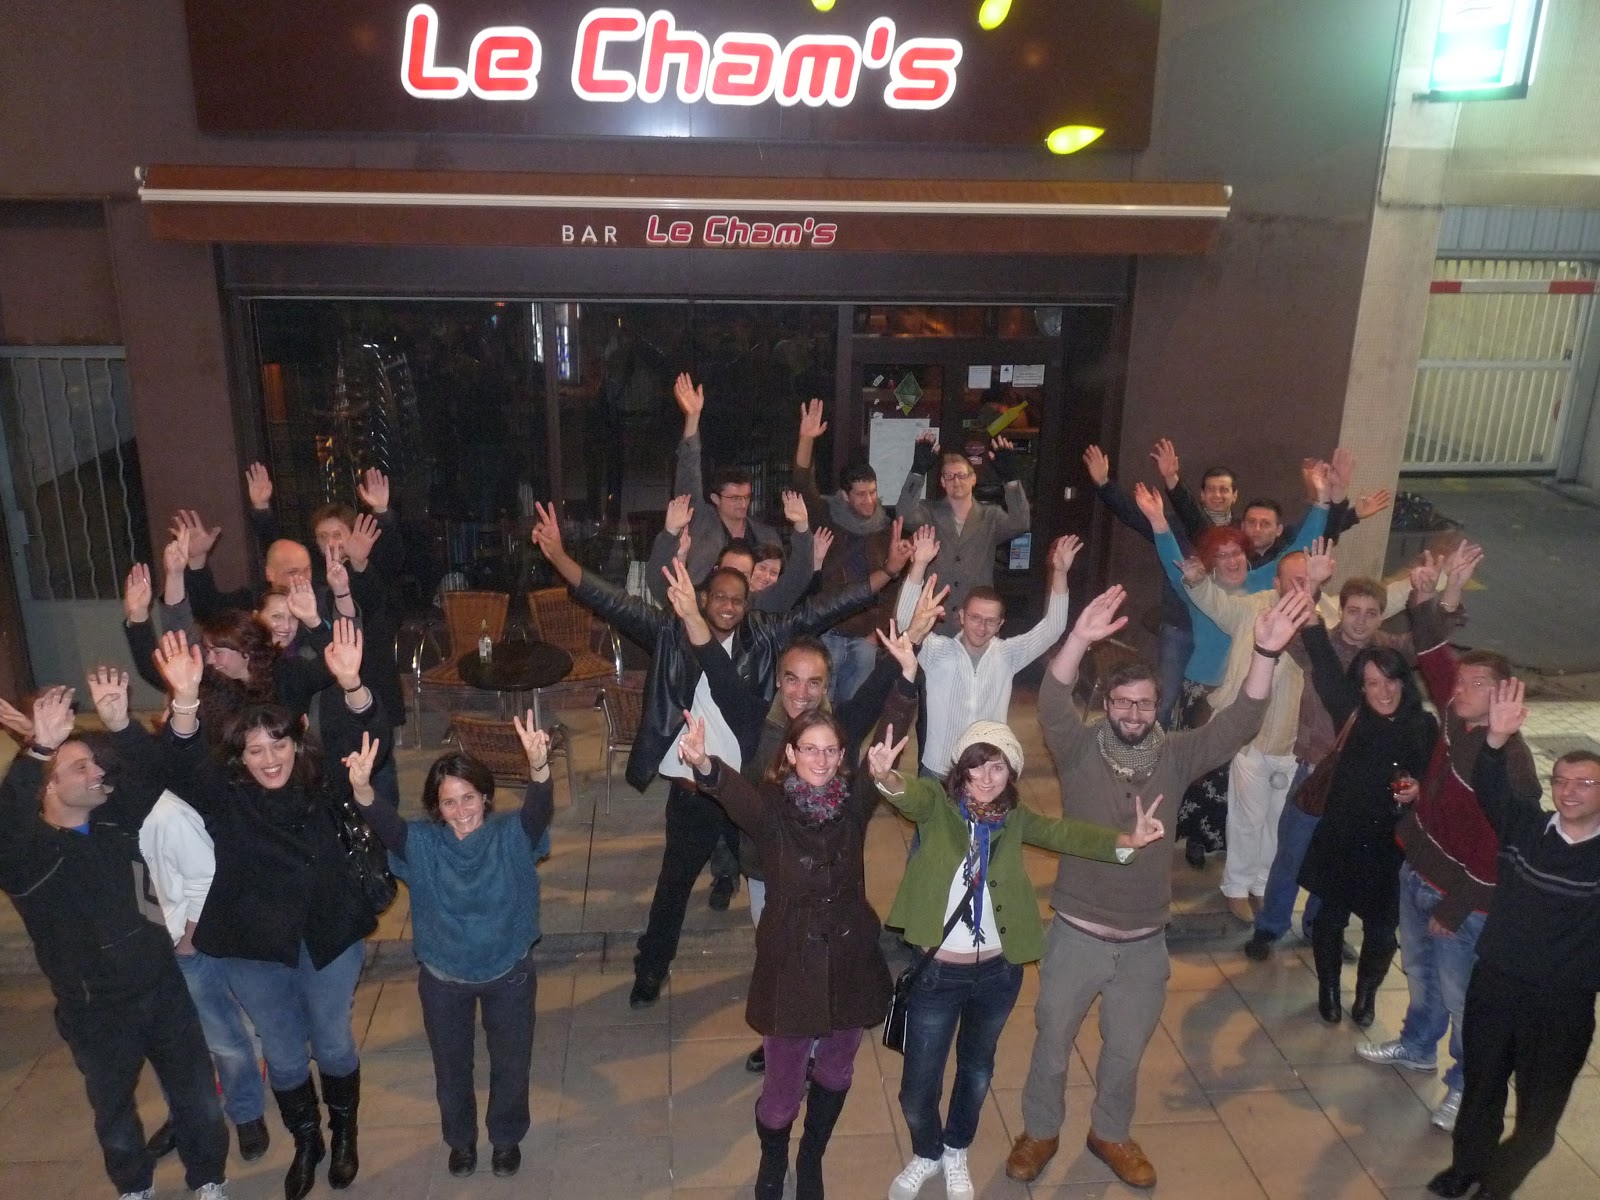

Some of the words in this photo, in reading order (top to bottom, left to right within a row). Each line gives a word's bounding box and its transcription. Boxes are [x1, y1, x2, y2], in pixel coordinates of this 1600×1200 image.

[401, 4, 542, 100] Le
[571, 8, 963, 110] Cham's
[562, 225, 617, 243] BAR
[646, 215, 693, 244] Le
[703, 215, 838, 245] Cham's
